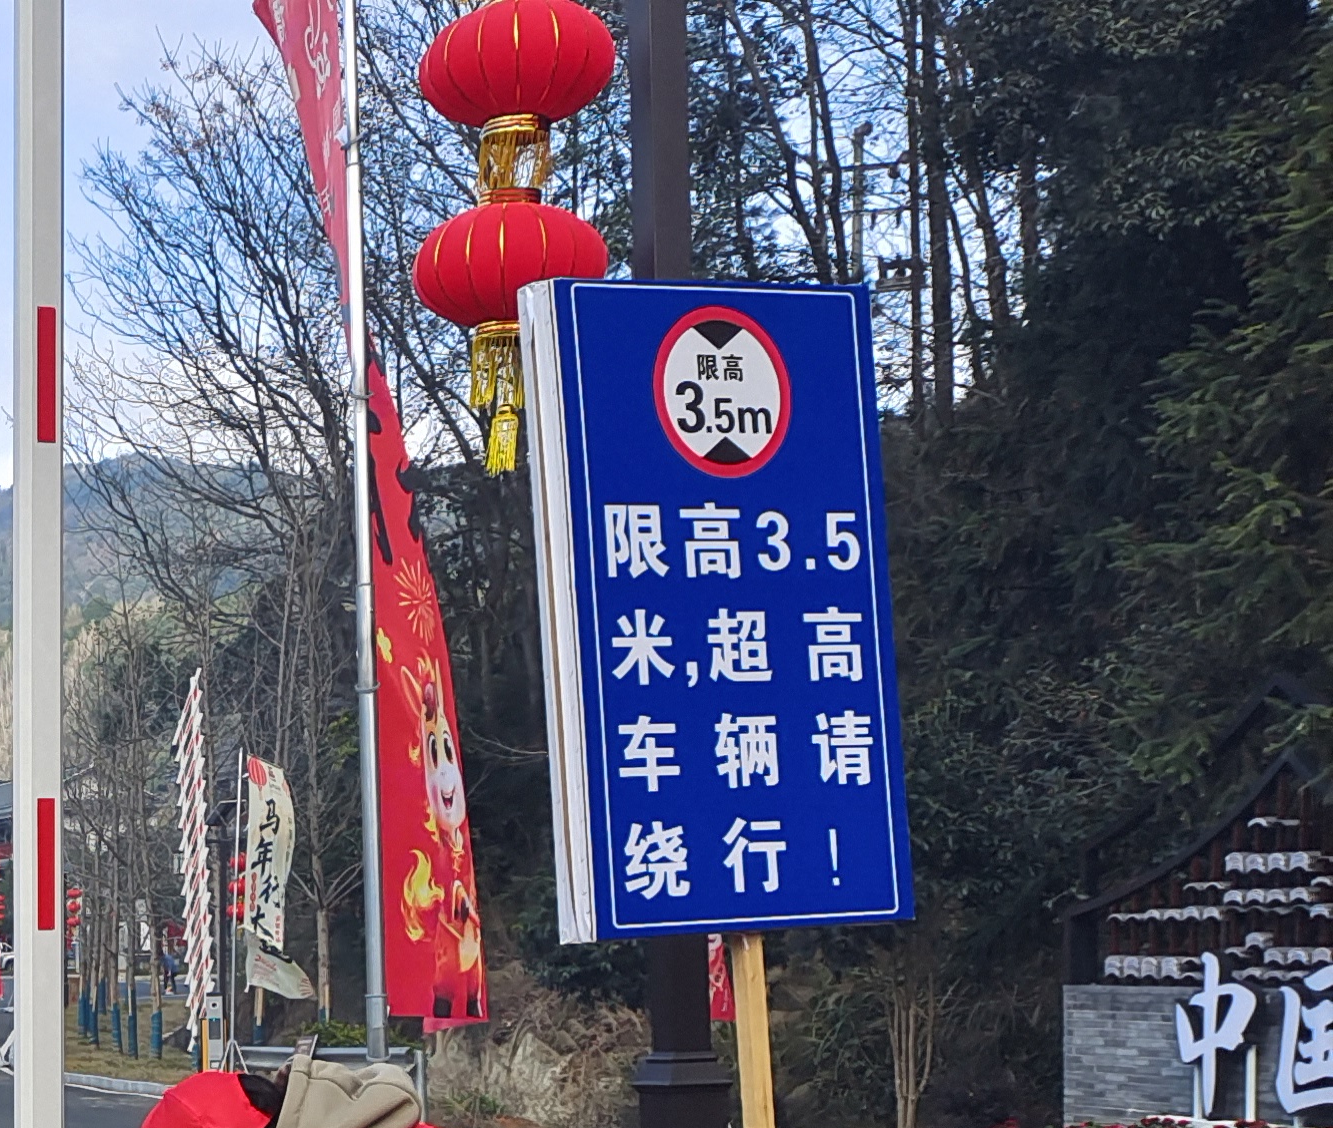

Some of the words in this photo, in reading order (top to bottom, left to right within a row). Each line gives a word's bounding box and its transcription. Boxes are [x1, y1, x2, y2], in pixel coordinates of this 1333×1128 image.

[697, 353, 744, 383] 限高
[675, 380, 774, 436] 3.5m
[603, 502, 862, 579] 限高3.5
[618, 710, 874, 792] 车辆请
